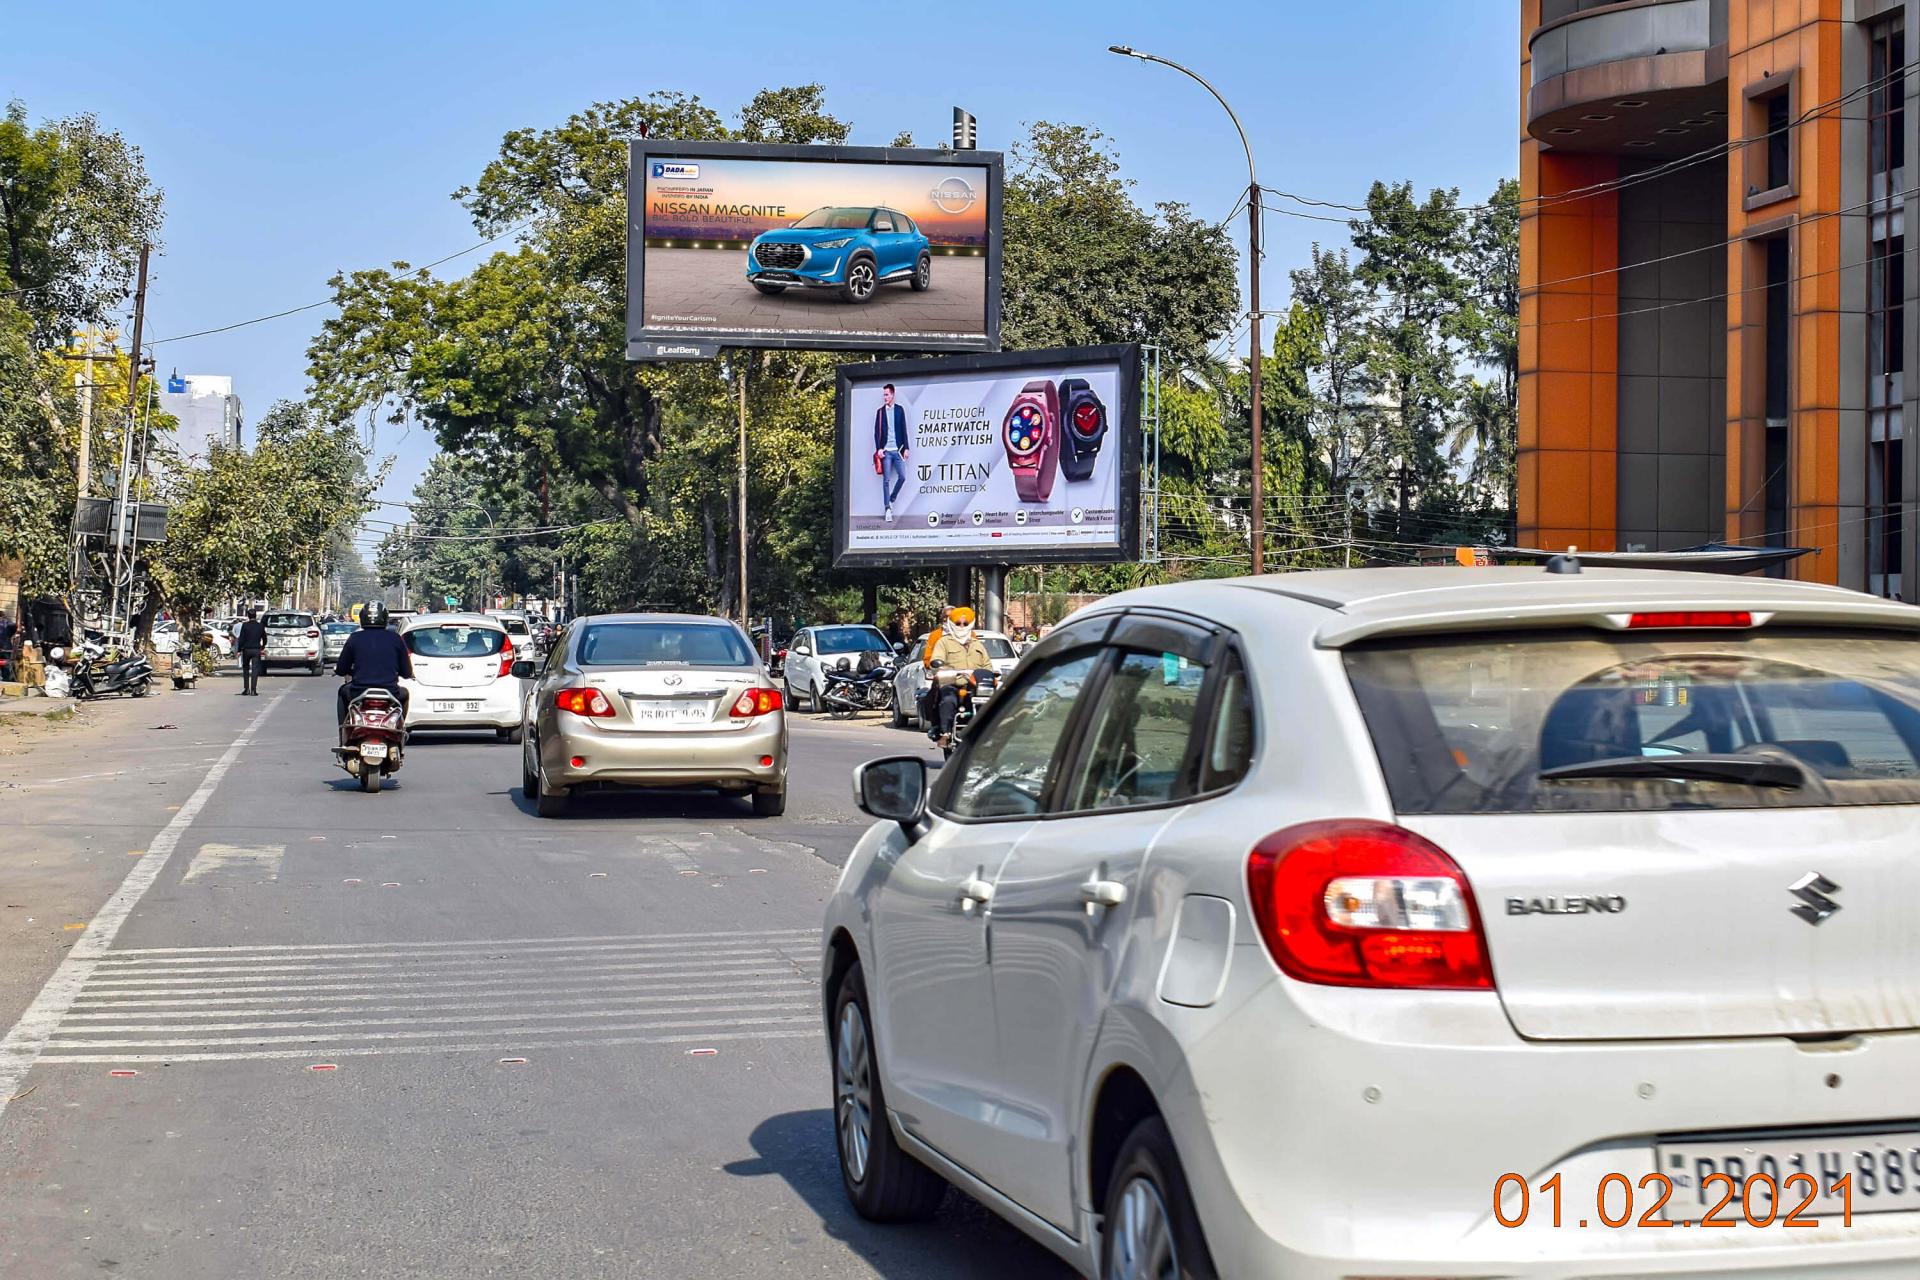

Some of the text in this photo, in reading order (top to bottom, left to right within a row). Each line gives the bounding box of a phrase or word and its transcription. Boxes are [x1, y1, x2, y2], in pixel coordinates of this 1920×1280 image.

[931, 191, 976, 199] NISSAN
[653, 202, 786, 217] NISSAN MAGNITE
[672, 215, 698, 223] BOLD
[702, 215, 753, 224] BEAUTIFUL
[663, 346, 700, 356] LeafBerry
[923, 407, 985, 421] FULL-TOUCH
[918, 420, 990, 434] SMARTWATCH
[915, 434, 993, 448] TURNS STYLISH
[938, 462, 990, 481] TITAN
[920, 484, 986, 495] CONNECTED X
[1506, 896, 1627, 915] BALENO
